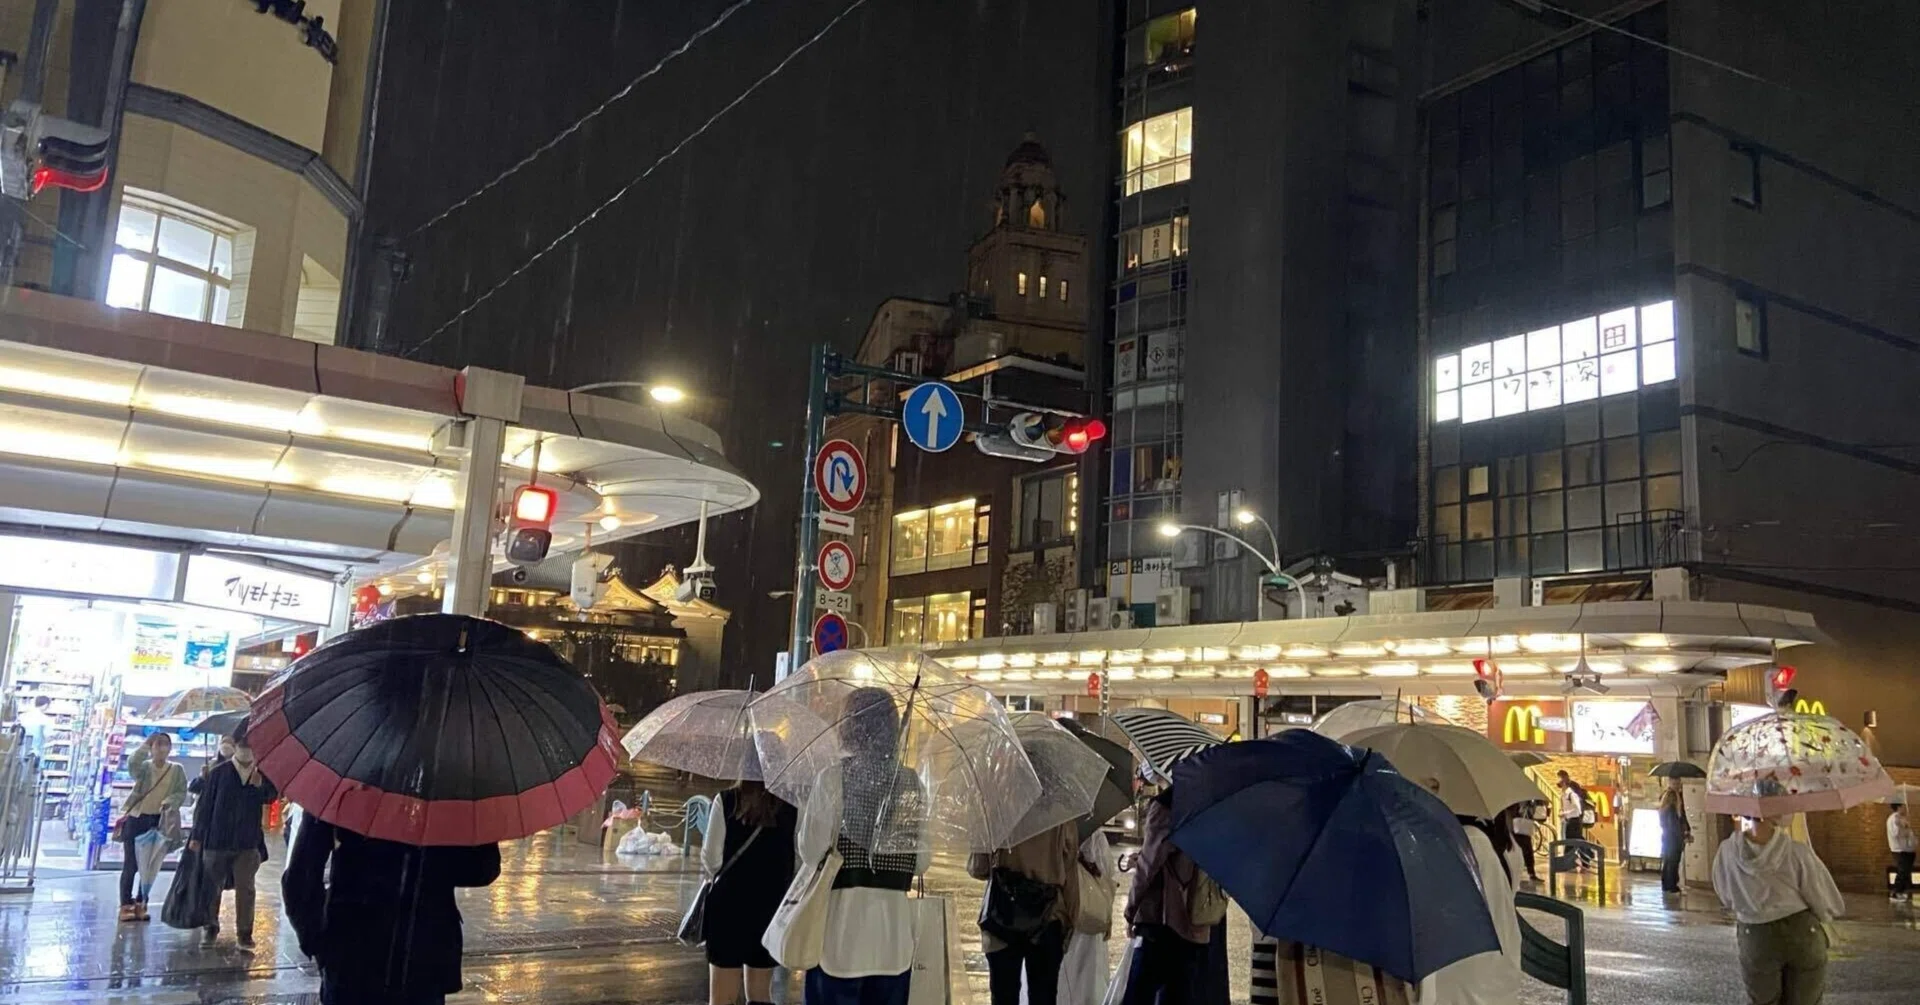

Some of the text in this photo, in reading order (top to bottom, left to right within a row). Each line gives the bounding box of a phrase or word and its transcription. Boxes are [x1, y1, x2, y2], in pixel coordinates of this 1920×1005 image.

[1471, 360, 1490, 377] 2F
[224, 575, 301, 611] マツモトキヨシ
